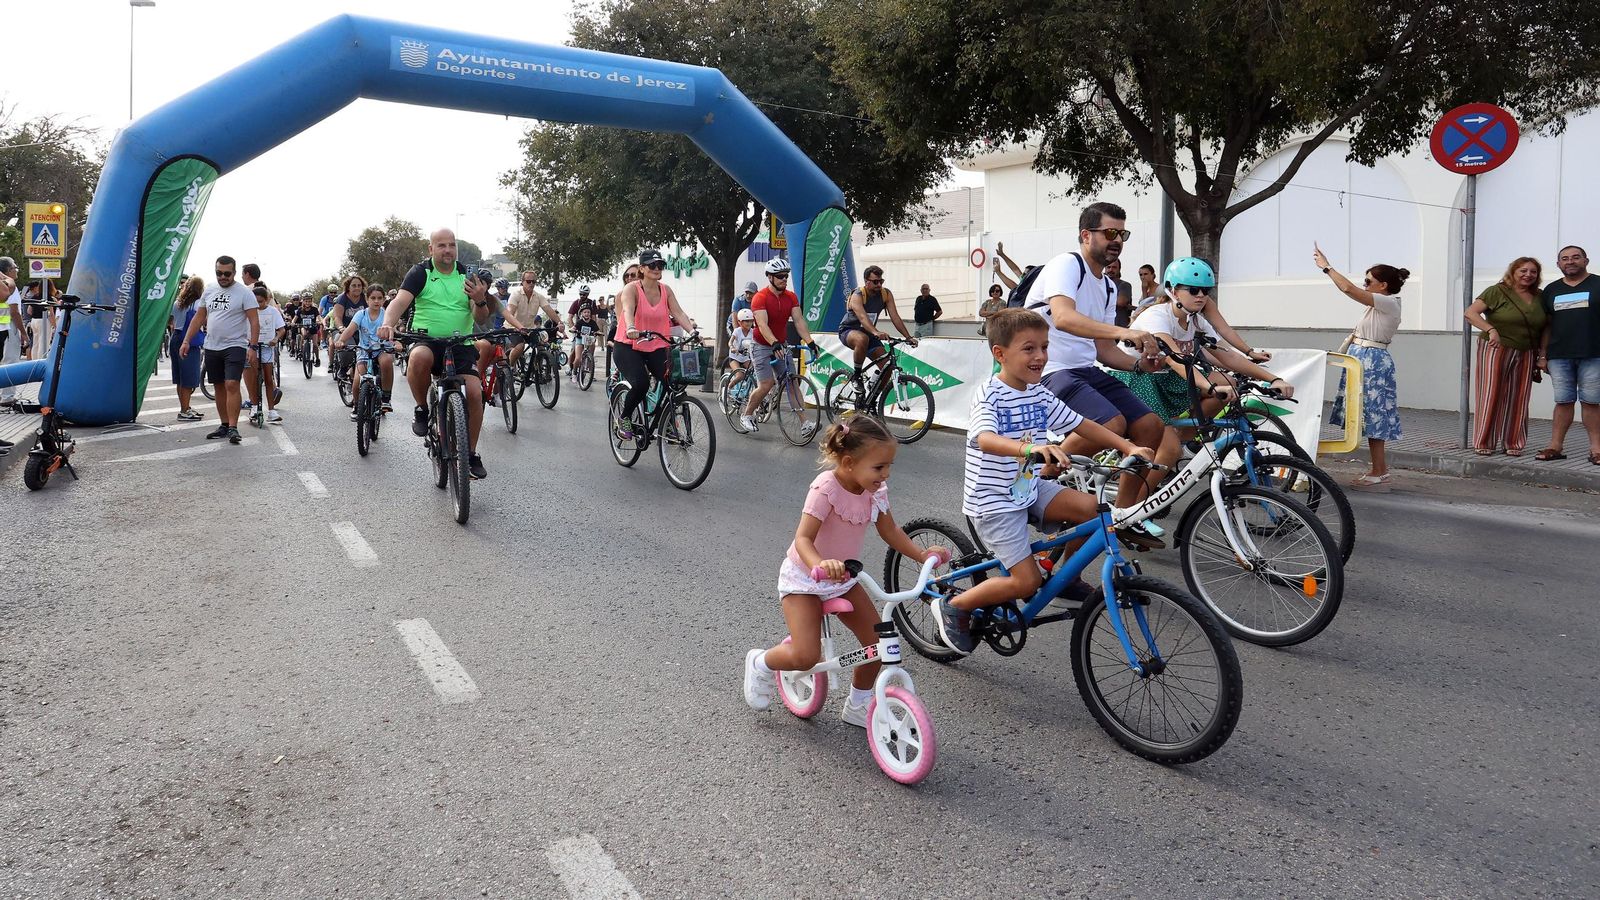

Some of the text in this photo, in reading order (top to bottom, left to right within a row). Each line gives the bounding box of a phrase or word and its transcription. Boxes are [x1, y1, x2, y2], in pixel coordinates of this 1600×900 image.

[436, 61, 516, 80] Deportes
[437, 48, 688, 90] Ayuntamiento de Jerez
[30, 247, 61, 255] PEATONES
